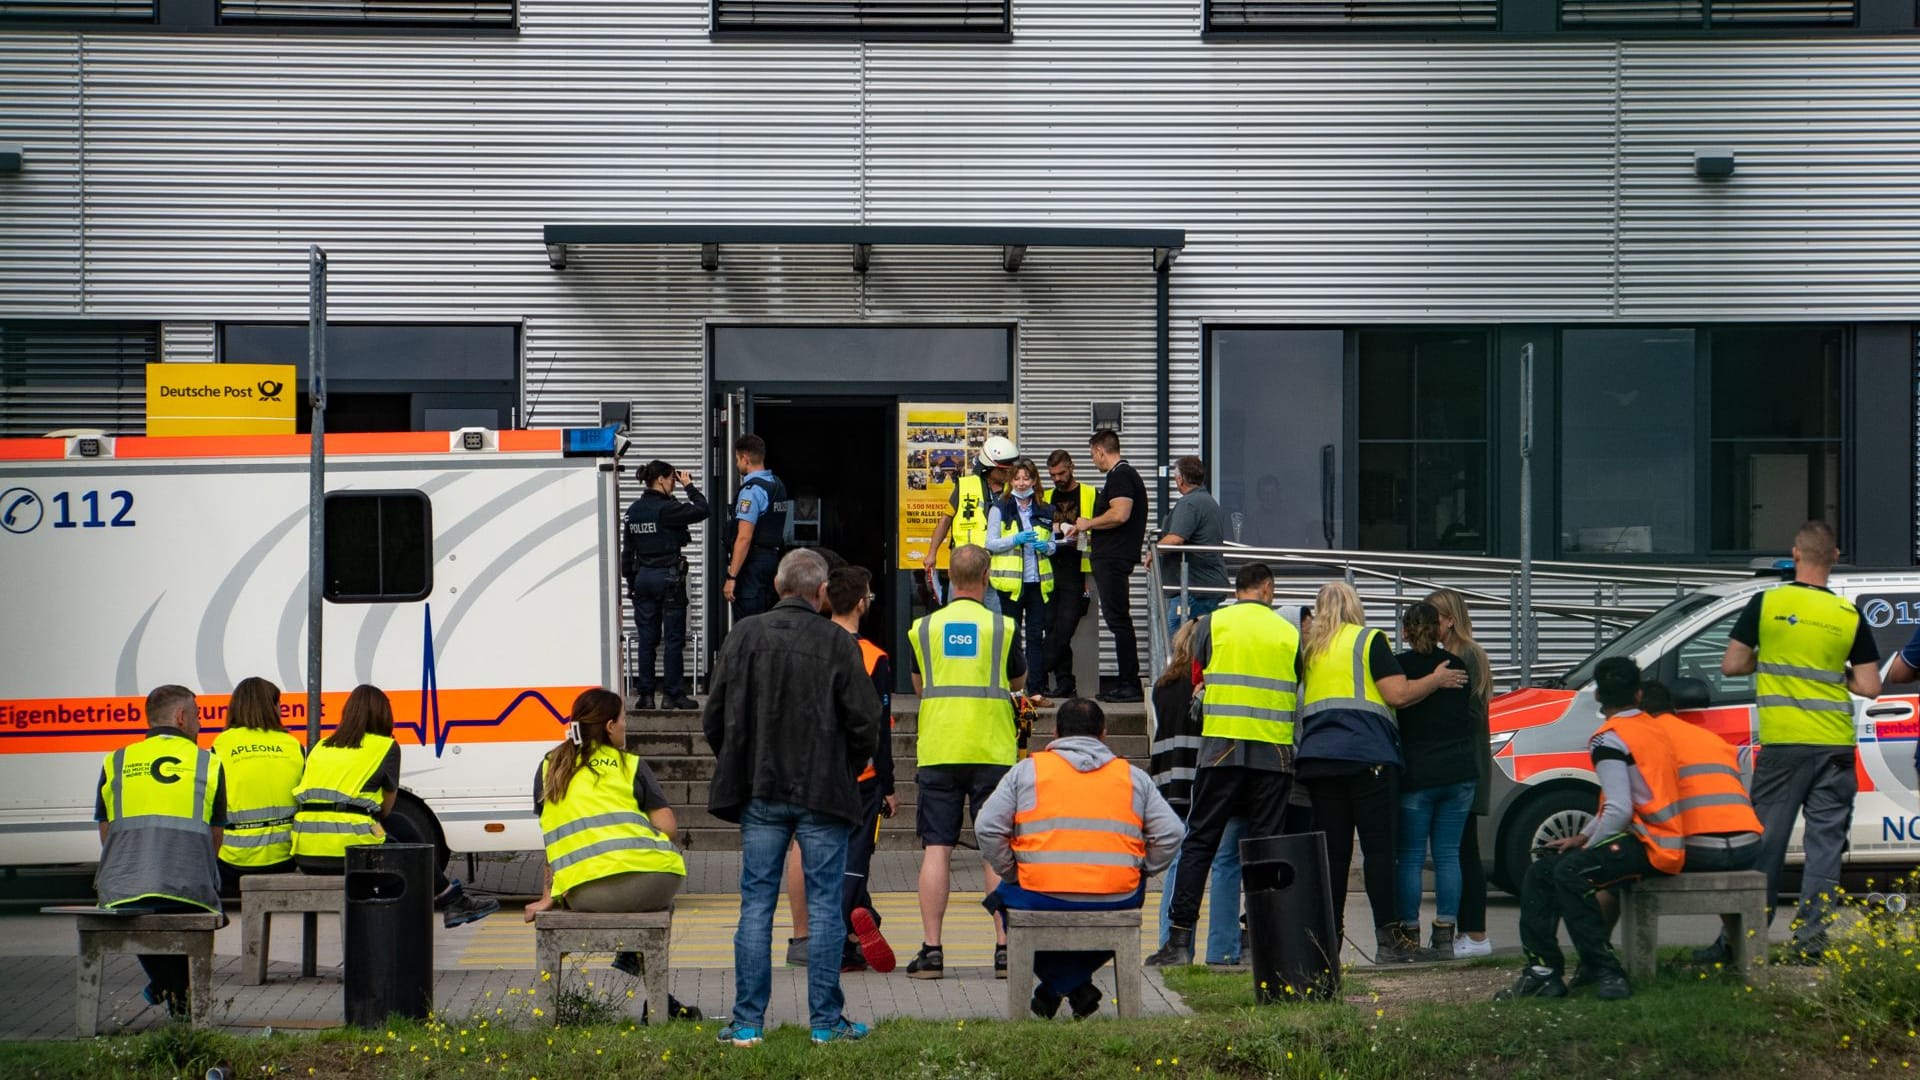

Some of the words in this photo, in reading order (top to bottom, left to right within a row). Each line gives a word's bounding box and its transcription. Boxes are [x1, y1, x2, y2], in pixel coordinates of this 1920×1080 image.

[160, 385, 220, 398] Deutsche
[224, 386, 253, 398] Post
[52, 490, 136, 528] 112
[629, 522, 657, 534] POLIZEI
[948, 634, 973, 645] CSG
[0, 702, 141, 729] Eigenbetrieb
[231, 744, 284, 756] APLEONA
